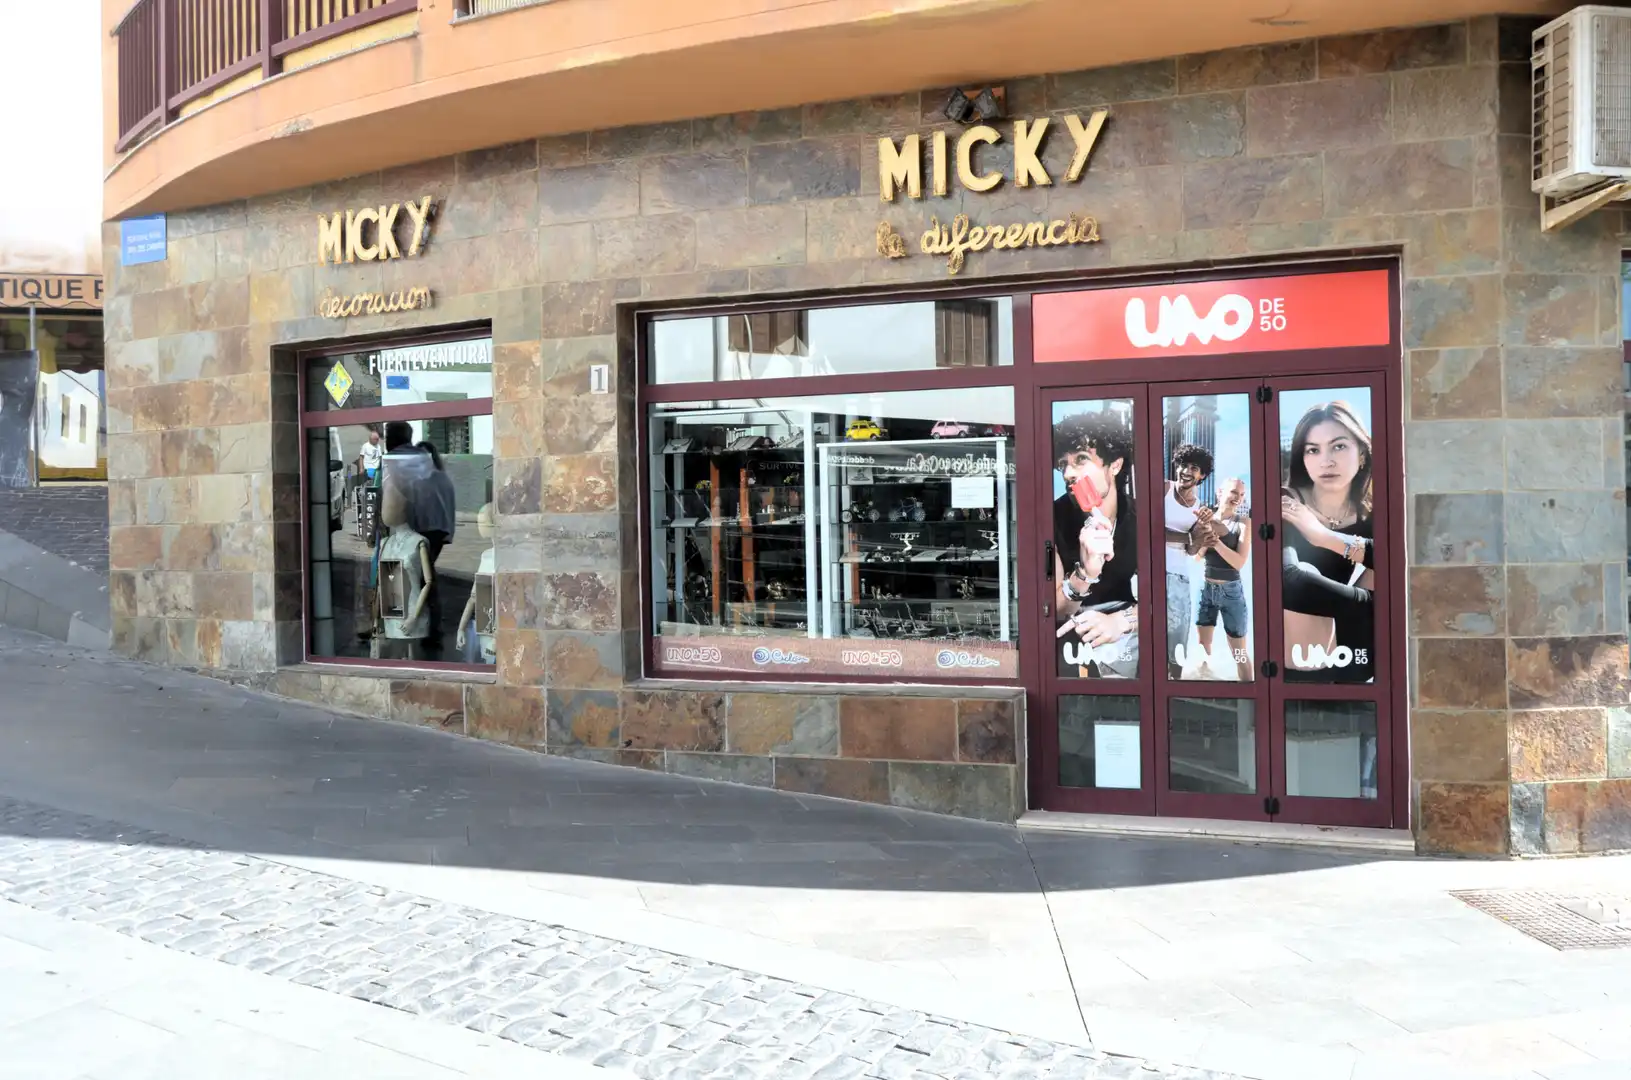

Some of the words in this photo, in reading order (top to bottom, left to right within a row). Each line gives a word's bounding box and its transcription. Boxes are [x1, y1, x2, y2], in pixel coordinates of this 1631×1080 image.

[878, 110, 1108, 201] MICKY
[318, 195, 432, 266] MICKY
[920, 212, 1101, 275] diferencia
[0, 278, 83, 299] TIQUE
[1259, 298, 1285, 314] DE
[1125, 294, 1254, 348] UNO
[1259, 314, 1287, 331] 50
[594, 367, 605, 391] 1
[842, 650, 870, 665] UNO
[880, 650, 902, 666] 50
[1234, 648, 1247, 656] DE
[1234, 656, 1247, 664] 50
[1292, 643, 1353, 668] UNO
[1354, 648, 1368, 657] DE
[1354, 656, 1369, 665] 50
